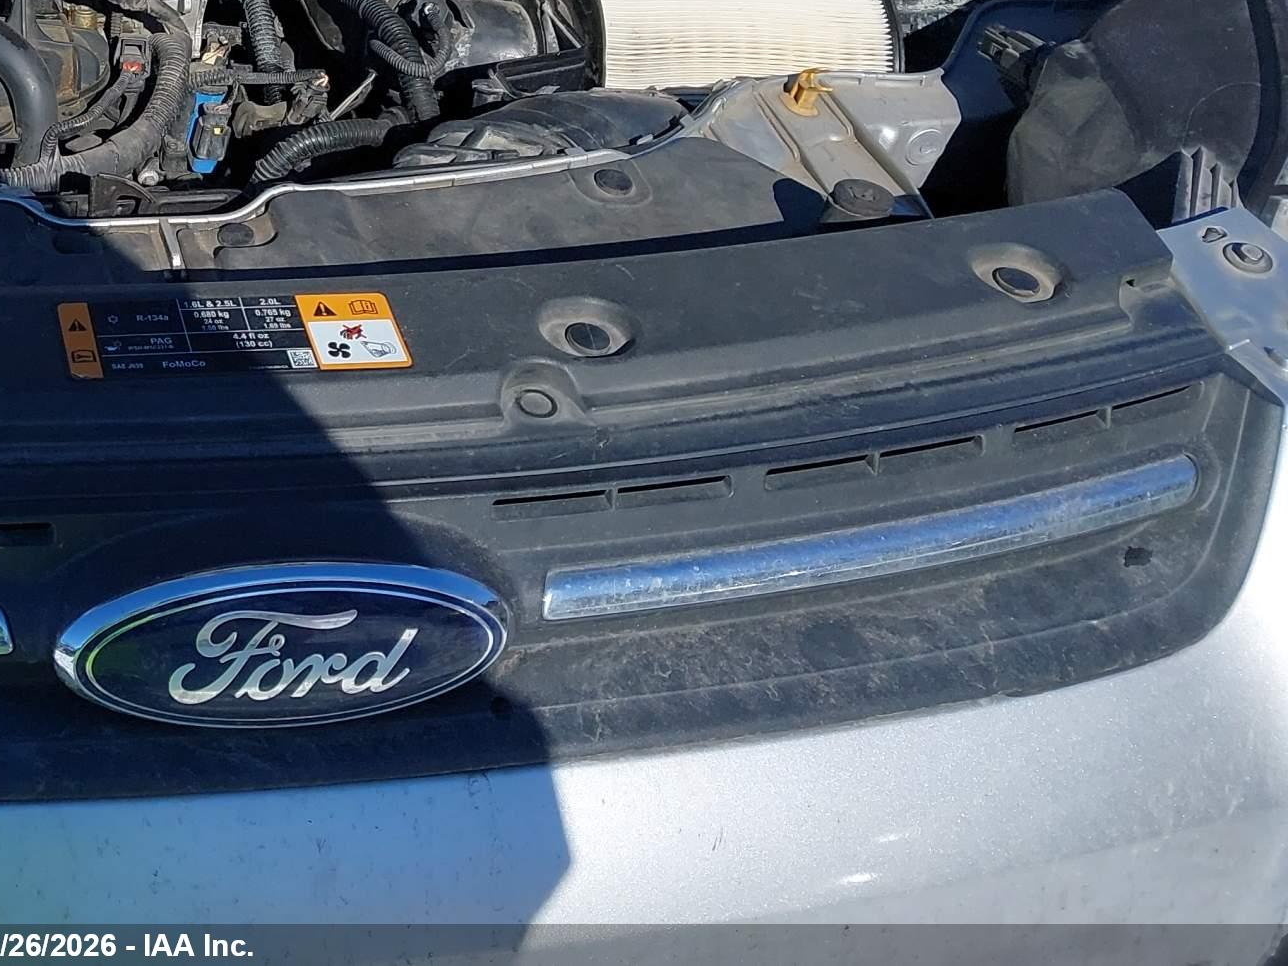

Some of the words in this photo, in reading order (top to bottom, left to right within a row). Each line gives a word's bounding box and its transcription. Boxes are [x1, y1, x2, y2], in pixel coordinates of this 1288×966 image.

[183, 300, 204, 308] 1.6L
[206, 300, 215, 308] &
[215, 299, 237, 307] 2.5L
[259, 297, 281, 305] 2.0L
[217, 310, 230, 319] kg
[255, 308, 278, 316] 0.765
[279, 308, 291, 317] kg
[150, 337, 172, 345] PAG
[235, 340, 256, 349] (130
[257, 340, 273, 348] cc)
[162, 360, 206, 369] FoMoCo
[168, 608, 419, 705] Ford
